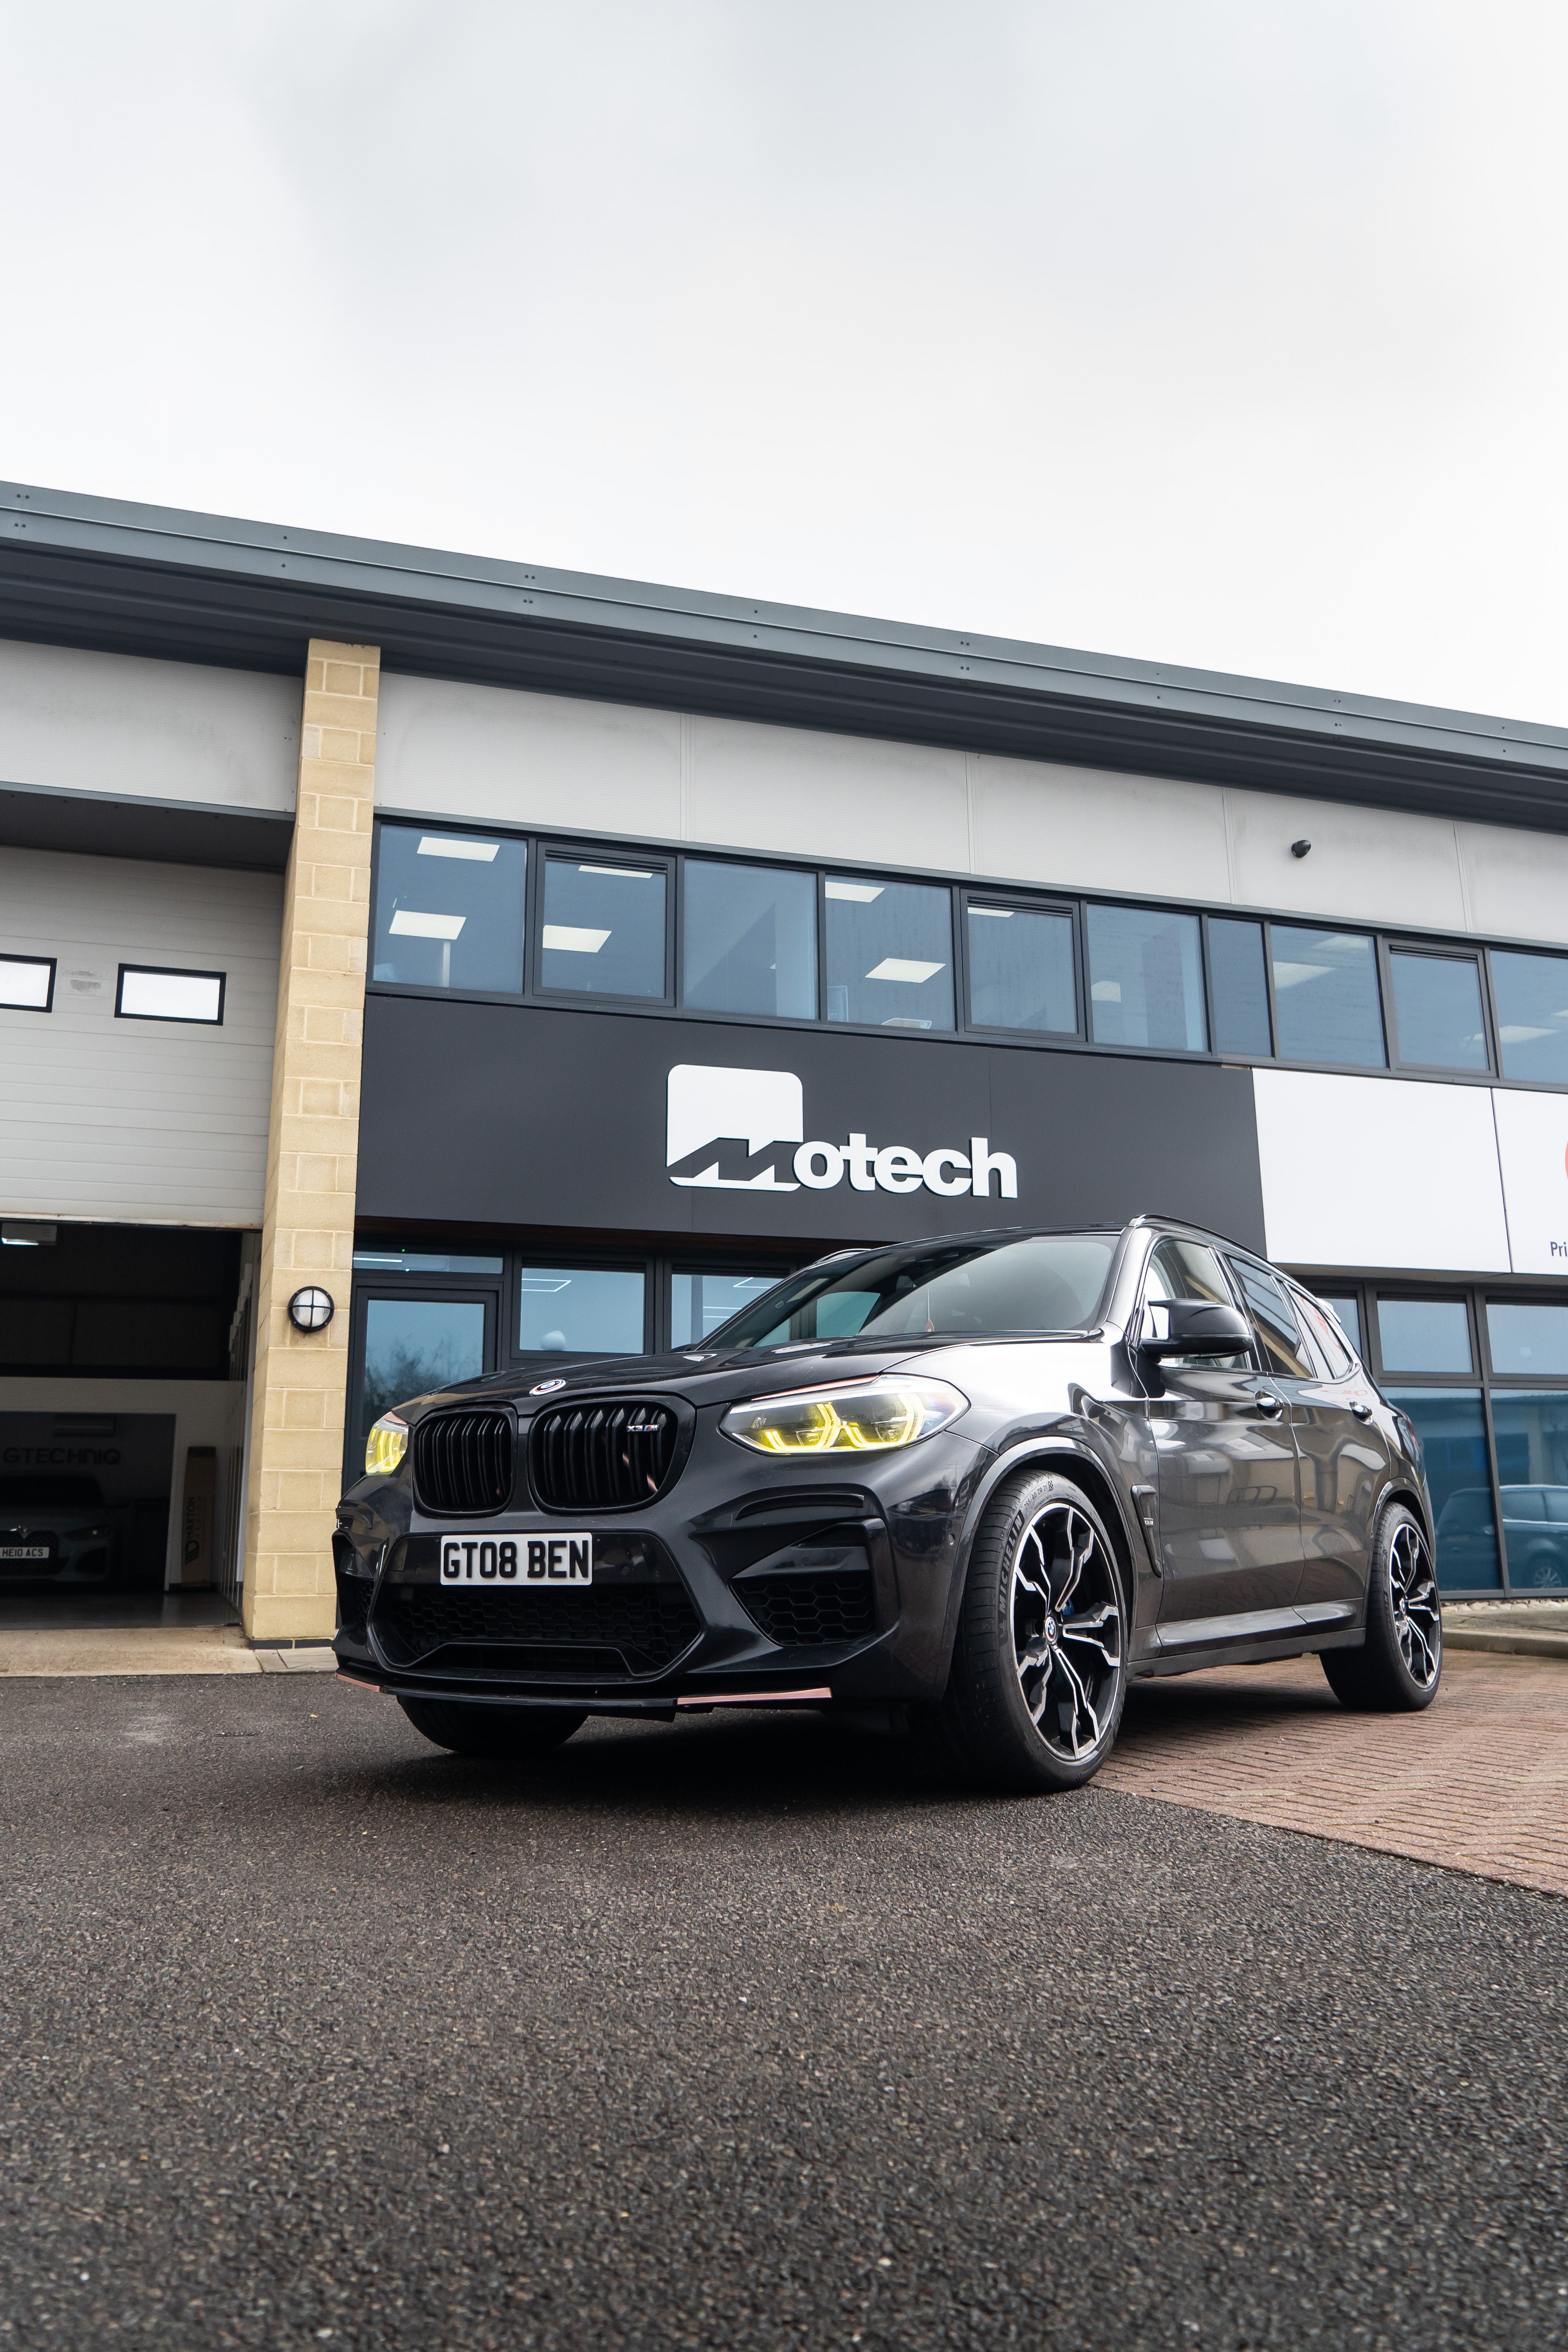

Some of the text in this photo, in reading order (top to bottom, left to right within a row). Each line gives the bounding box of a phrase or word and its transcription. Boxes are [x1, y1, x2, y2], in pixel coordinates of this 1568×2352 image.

[1024, 1492, 1037, 1510] 255/40
[1037, 1487, 1043, 1495] ZR
[186, 1497, 195, 1539] MAXTON
[26, 1548, 44, 1557] ACS
[443, 1540, 589, 1578] GT08 BEN
[999, 1514, 1023, 1615] MICHELIN
